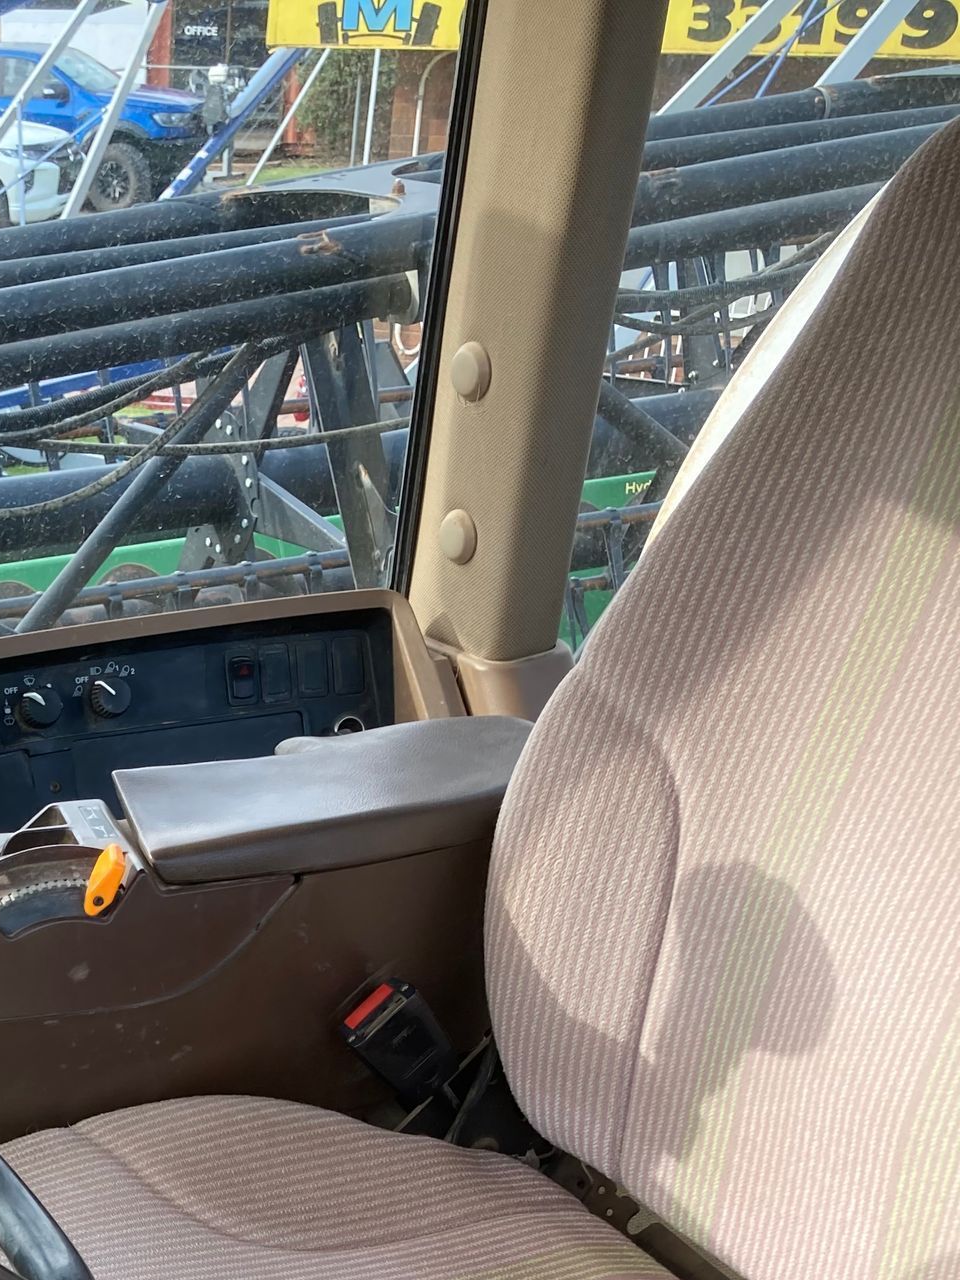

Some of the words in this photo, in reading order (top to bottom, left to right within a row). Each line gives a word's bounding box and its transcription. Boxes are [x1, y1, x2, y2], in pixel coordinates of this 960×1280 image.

[184, 25, 219, 37] OFFICE
[74, 675, 90, 684] OFF
[3, 686, 19, 696] OFF
